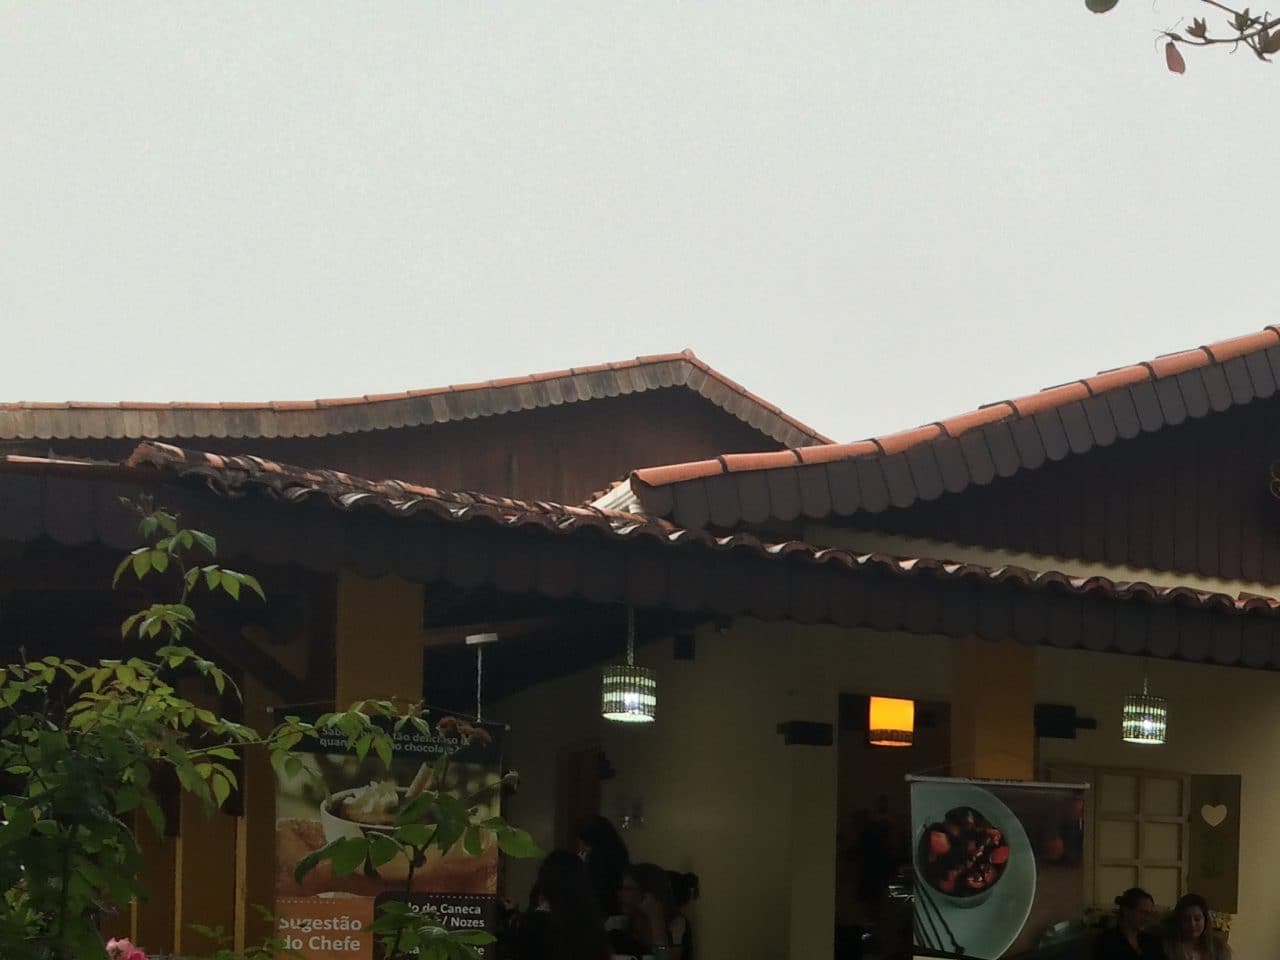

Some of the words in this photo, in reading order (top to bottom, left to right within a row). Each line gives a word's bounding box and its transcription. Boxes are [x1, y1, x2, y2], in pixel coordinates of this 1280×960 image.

[440, 903, 481, 915] Caneca
[279, 915, 362, 933] Sugestão
[450, 916, 485, 928] Nozes
[308, 936, 361, 951] Chefe
